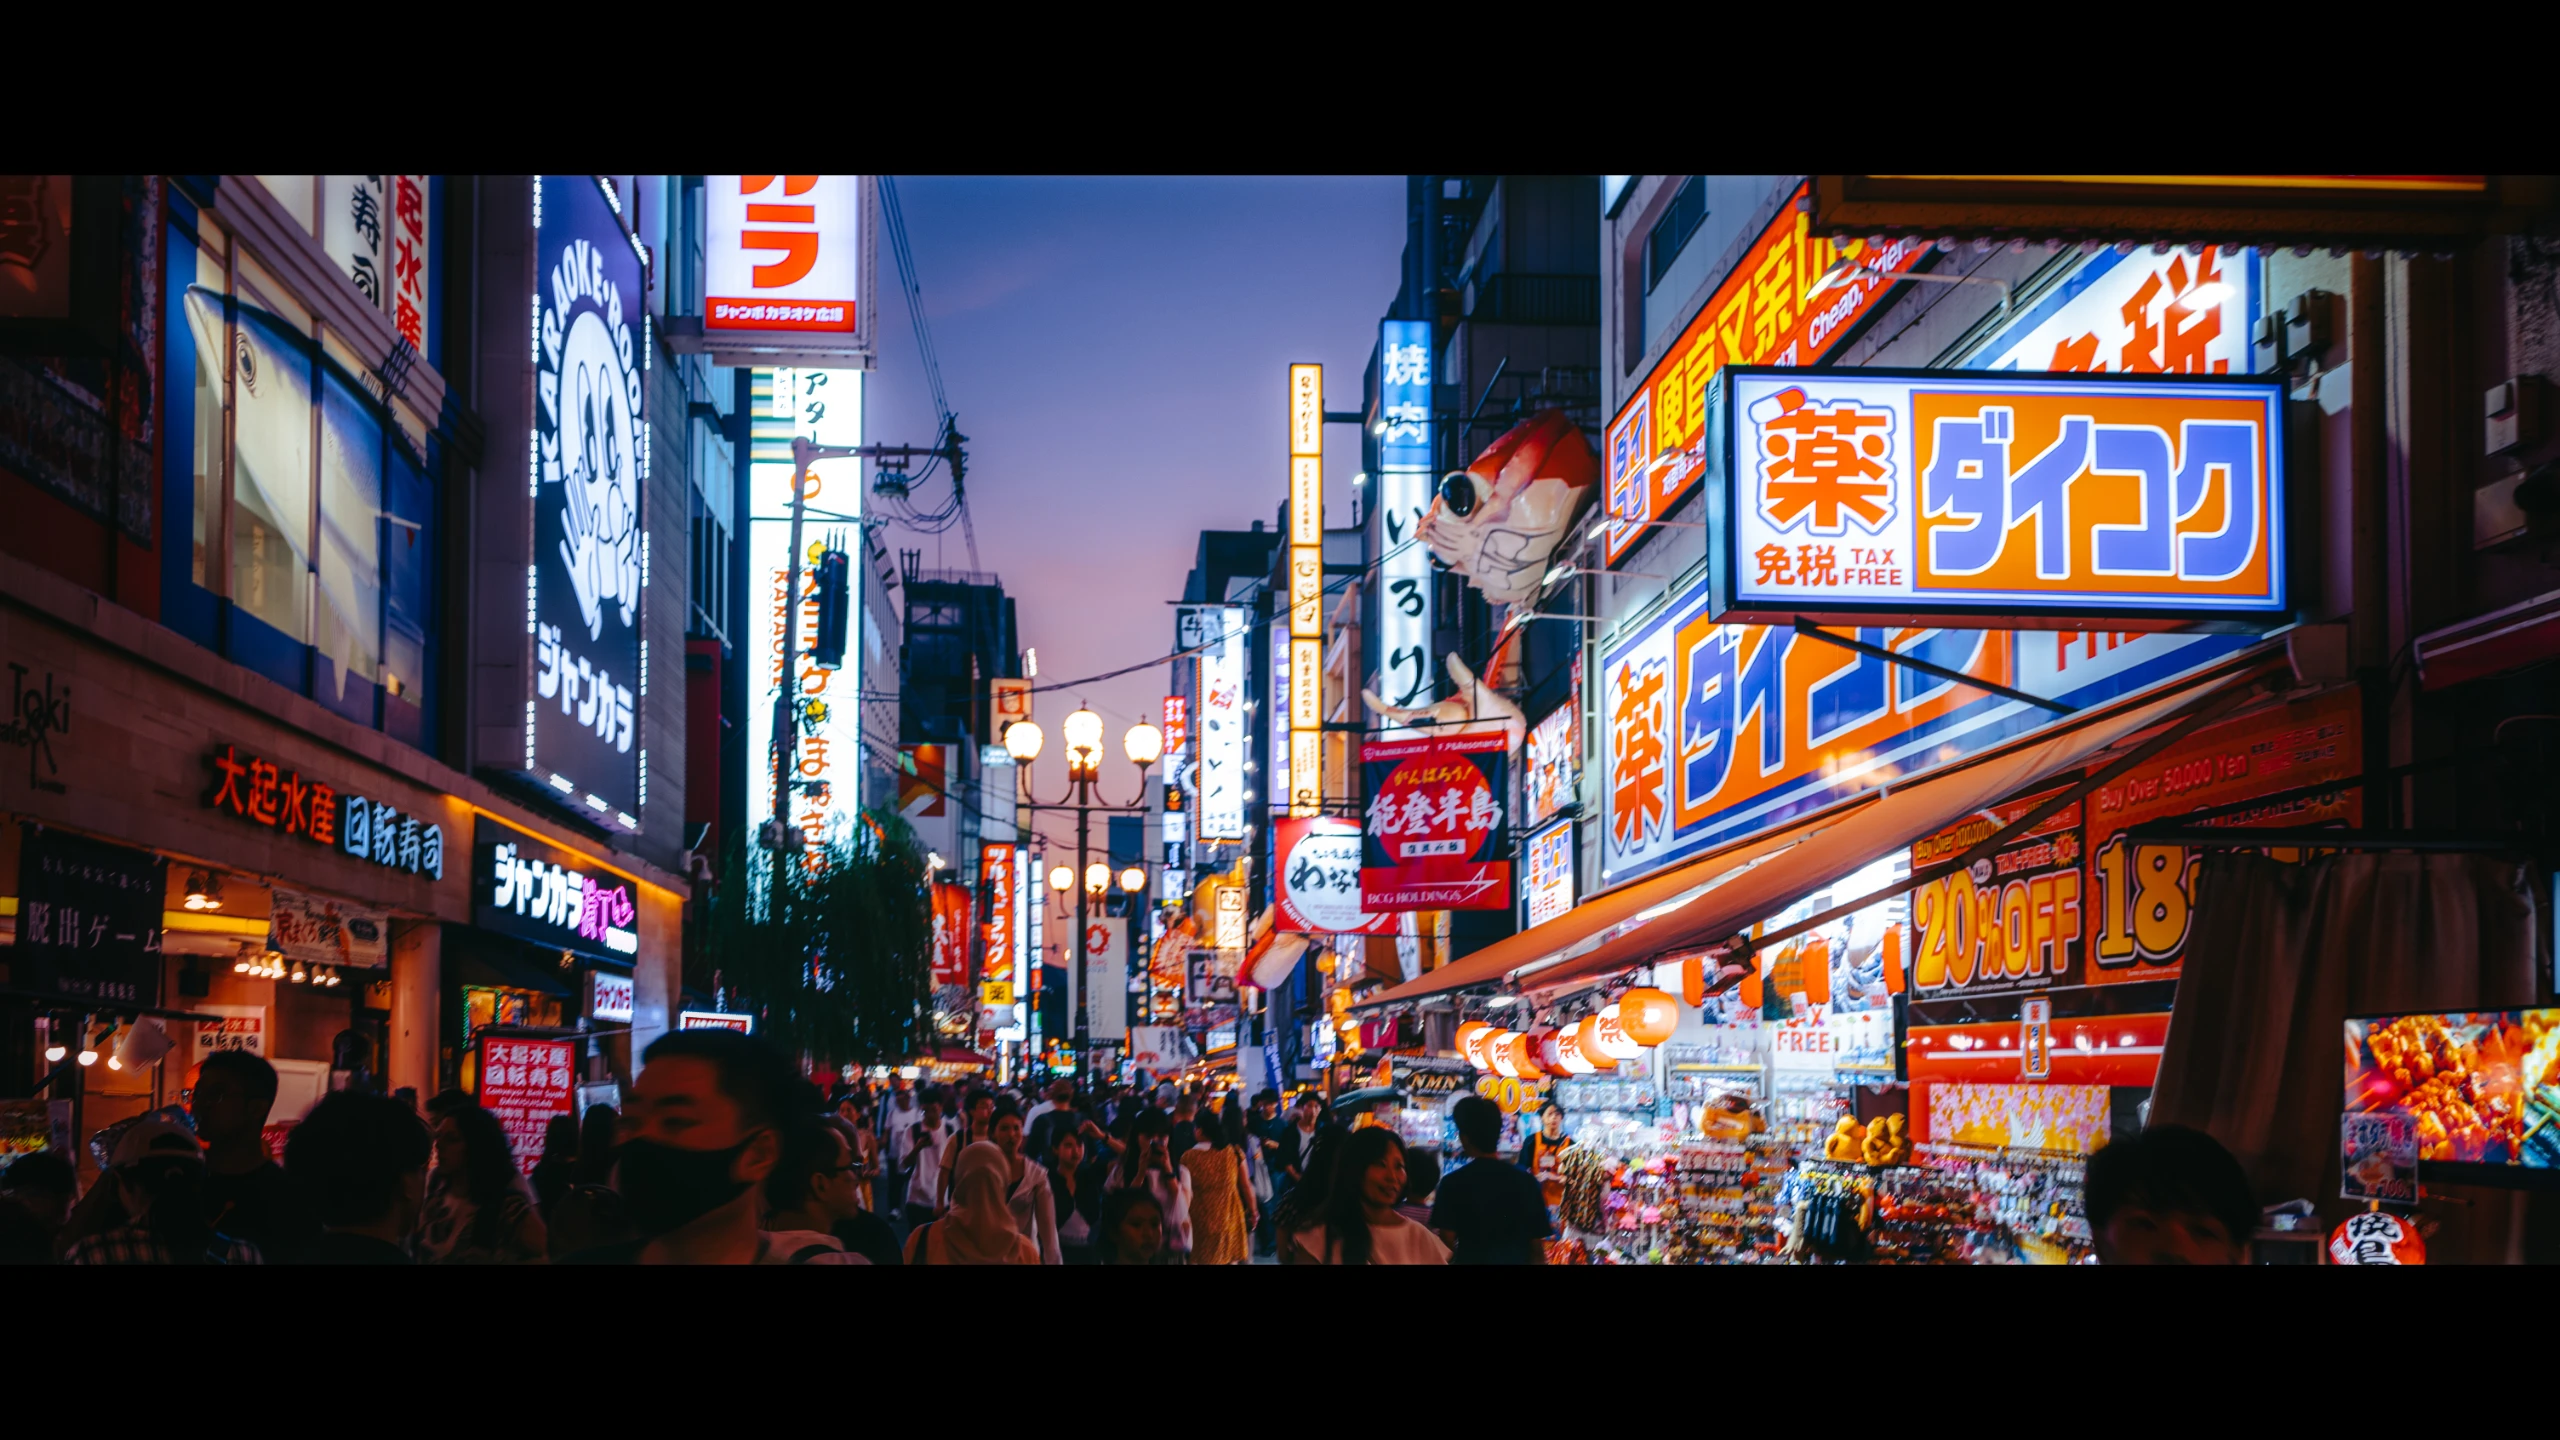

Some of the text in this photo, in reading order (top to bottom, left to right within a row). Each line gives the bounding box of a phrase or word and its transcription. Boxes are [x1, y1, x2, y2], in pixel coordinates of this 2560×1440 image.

[351, 175, 381, 309] 寿司
[715, 304, 844, 323] ジャンボカラオケ広場
[1809, 283, 1864, 349] Cheap,
[2050, 248, 2231, 375] 税
[1384, 343, 1431, 444] 焼肉
[1758, 397, 1892, 530] 薬
[1923, 406, 2259, 581] ダイコク
[1754, 543, 1839, 587] 免税
[1844, 568, 1903, 586] FREE
[1851, 547, 1894, 565] TAX
[1386, 506, 1425, 704] いろり
[538, 621, 634, 754] ジャンカラ
[1612, 662, 1666, 842] 薬
[2101, 787, 2124, 813] Buy
[2127, 776, 2161, 806] Over
[2218, 753, 2247, 781] Yen
[214, 744, 337, 847] 大起水産
[1365, 786, 1504, 838] 能登半島
[343, 795, 445, 883] 回転寿司
[1916, 836, 1933, 860] Buy
[1934, 832, 1954, 853] Over
[494, 843, 583, 930] ジャンカラ
[1397, 889, 1462, 902] HOLDINGS
[2097, 833, 2202, 965] 18
[26, 899, 162, 953] 脱出ゲーム
[489, 1043, 568, 1067] 大起水産
[1777, 1030, 1830, 1053] FREE
[484, 1063, 571, 1089] 回転寿司
[1410, 1072, 1459, 1091] NMN
